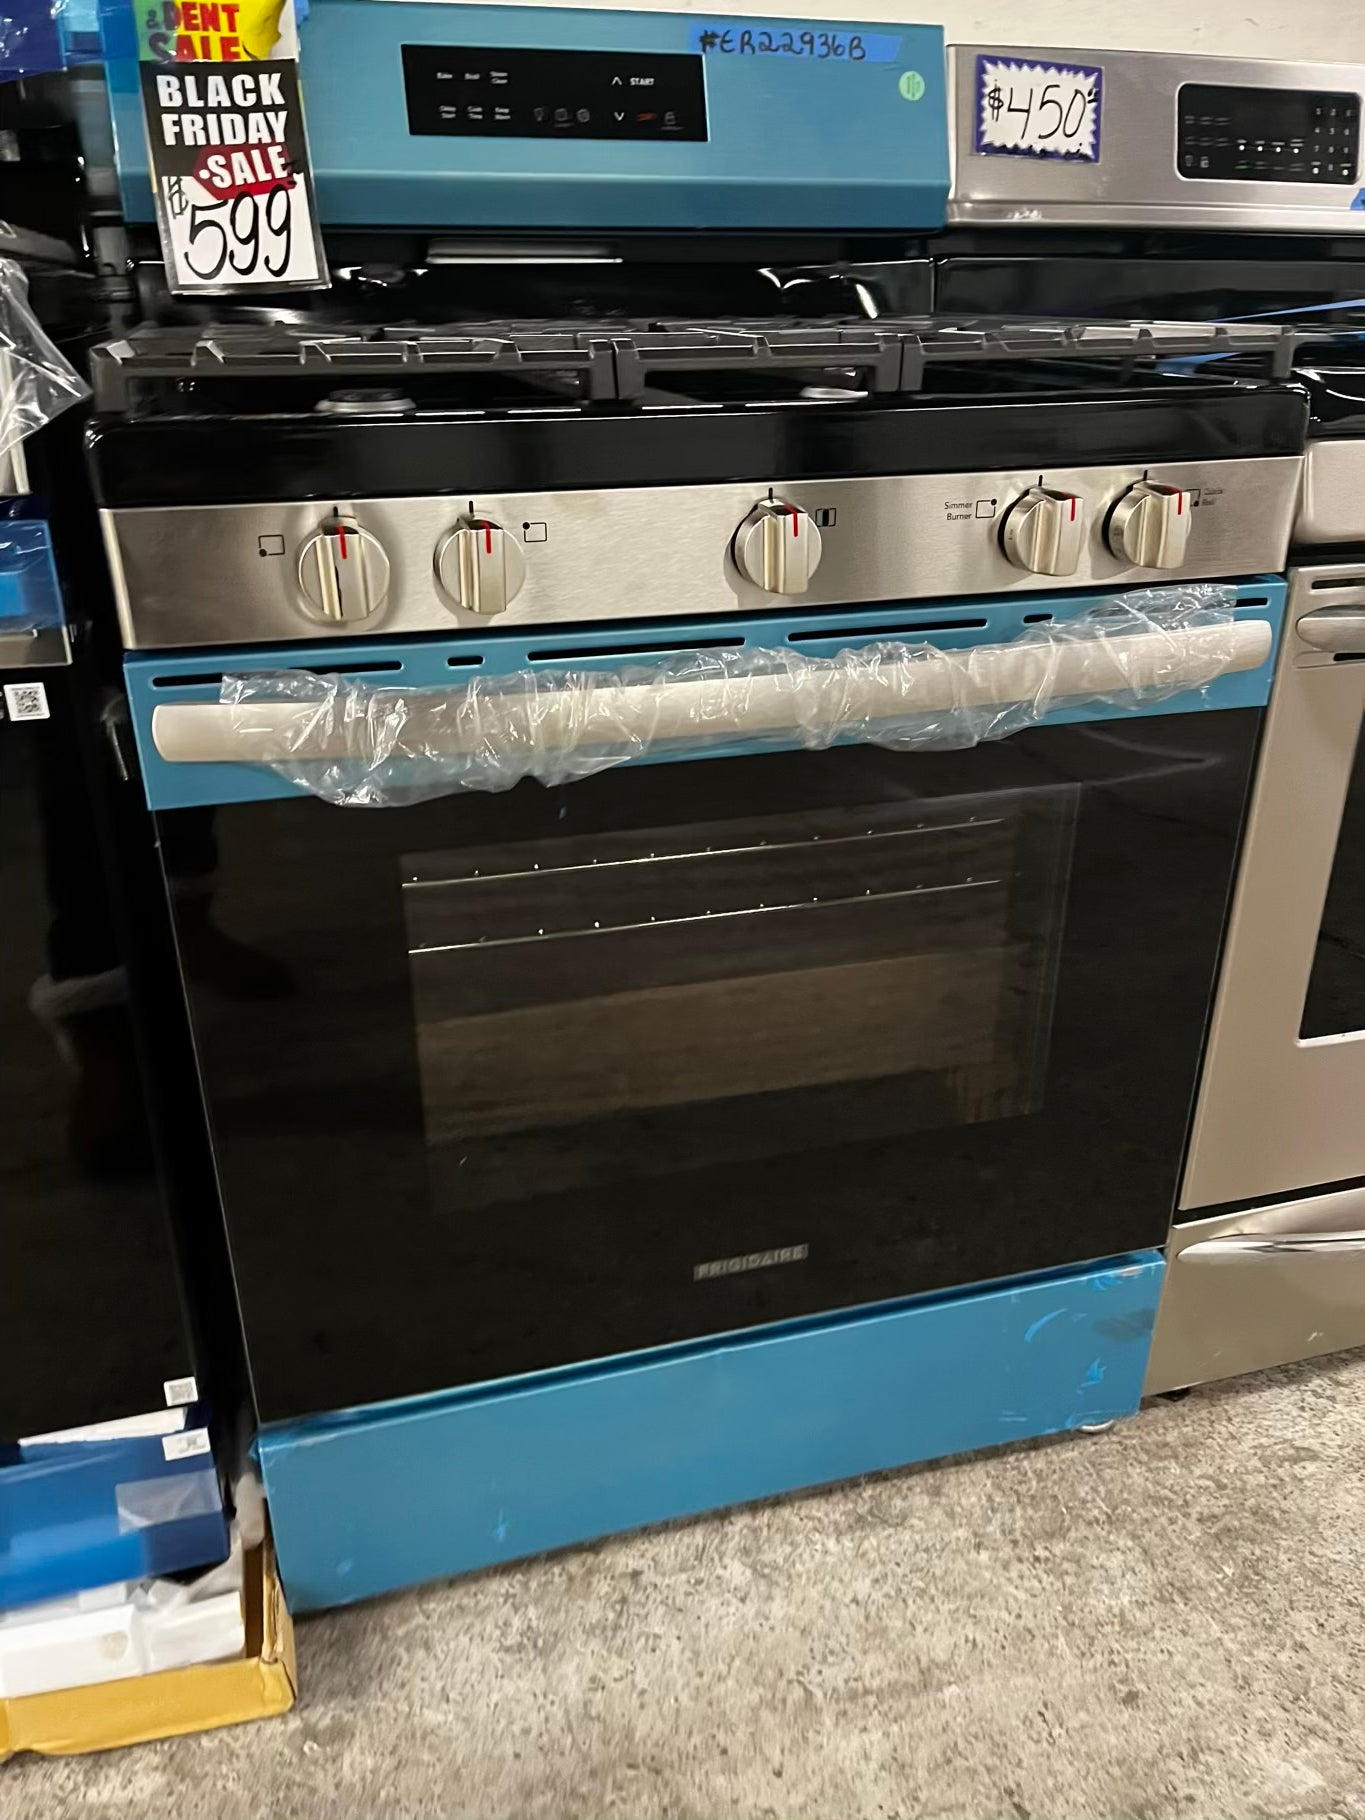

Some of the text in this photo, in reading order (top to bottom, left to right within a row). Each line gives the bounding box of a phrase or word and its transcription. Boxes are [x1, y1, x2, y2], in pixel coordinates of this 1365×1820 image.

[146, 0, 240, 32] & DENT
[156, 73, 285, 107] BLACK
[630, 77, 655, 86] START
[161, 111, 288, 146] FRIDAY
[206, 145, 288, 189] SALE
[944, 501, 973, 510] Simmer
[946, 512, 972, 521] Burner
